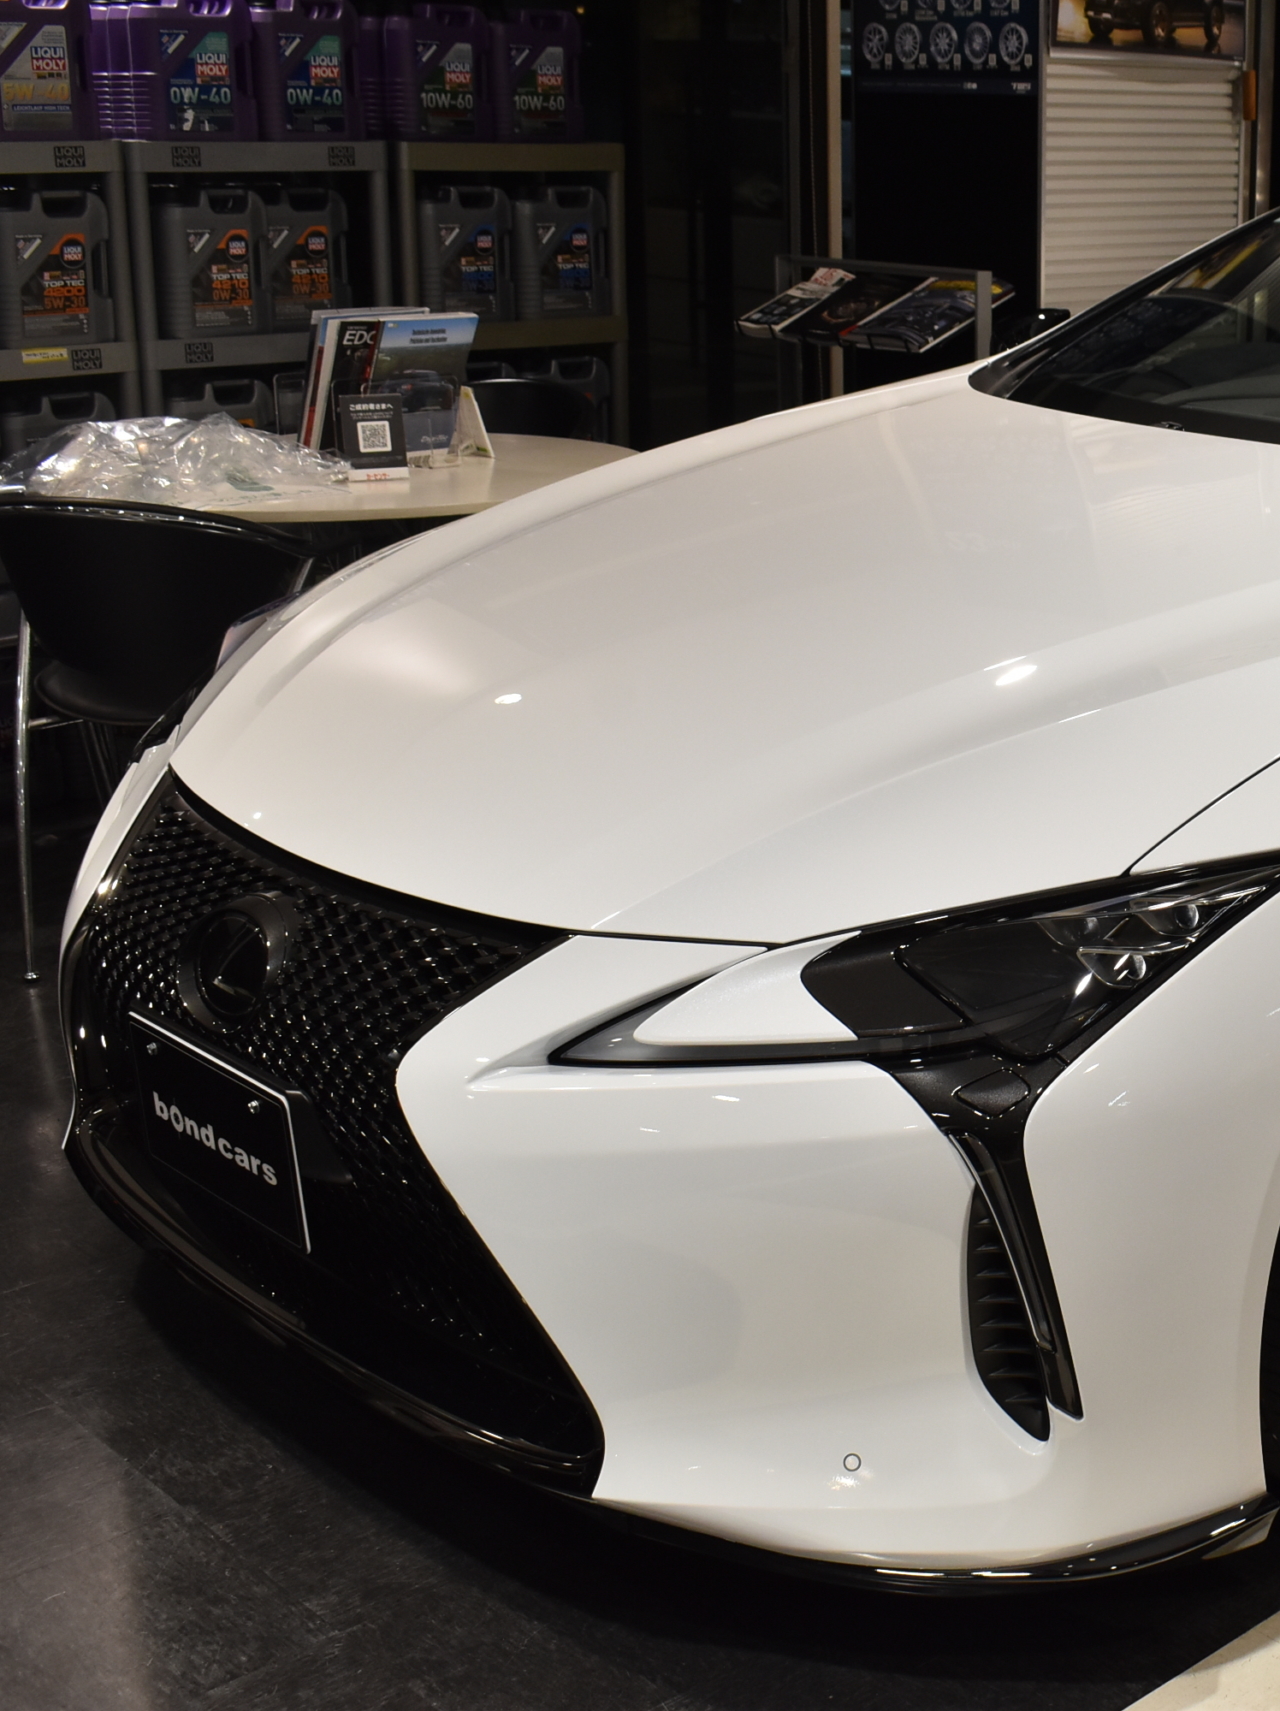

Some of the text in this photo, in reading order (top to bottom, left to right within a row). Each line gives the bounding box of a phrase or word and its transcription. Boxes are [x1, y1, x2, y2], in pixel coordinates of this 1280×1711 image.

[32, 47, 64, 58] LIQUI
[196, 53, 227, 64] LIQUI
[311, 56, 338, 66] LIQUI
[32, 59, 66, 70] MOLY
[445, 63, 470, 72] LIQUI
[537, 65, 562, 74] LIQUI
[197, 65, 228, 76] MOLY
[311, 67, 339, 78] MOLY
[446, 73, 471, 83] MOLY
[538, 75, 563, 85] MOLY
[2, 83, 70, 101] 5W-40
[170, 87, 231, 104] 0W-40
[287, 88, 342, 105] 0W-40
[420, 93, 474, 109] 10W-60
[513, 95, 565, 111] 10W-60
[55, 147, 83, 156] LIQUI
[173, 147, 199, 156] LIQUI
[56, 157, 84, 167] MOLY
[174, 157, 201, 166] MOLY
[43, 280, 64, 288] TOP
[212, 279, 249, 289] 4210
[43, 287, 85, 297] 4200
[213, 289, 249, 300] 0W-30
[44, 297, 86, 309] 5W-30
[186, 343, 212, 352] LIQUI
[72, 350, 100, 360] LIQUI
[187, 353, 213, 362] MOLY
[73, 360, 102, 370] MOLY
